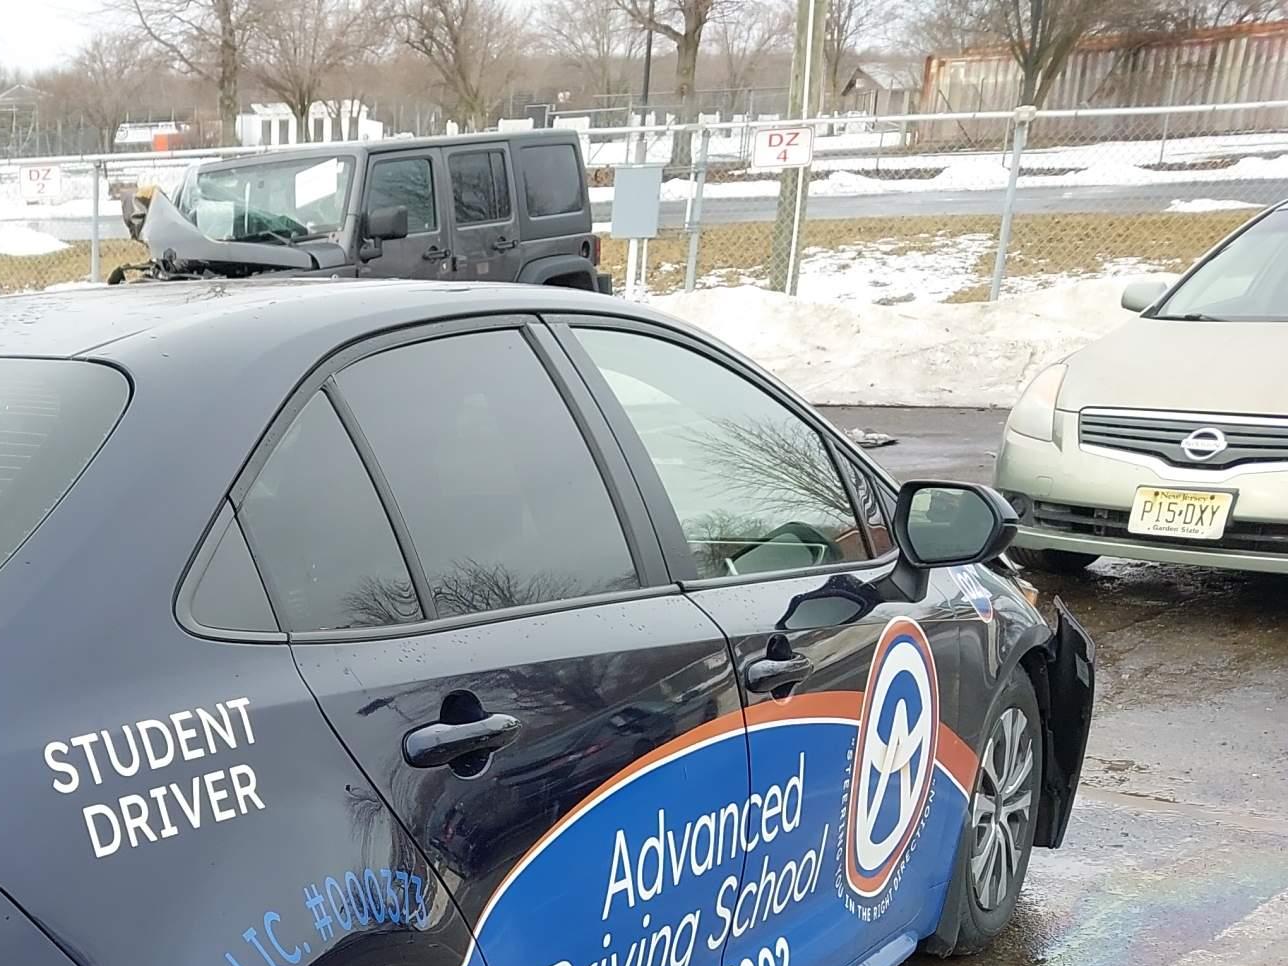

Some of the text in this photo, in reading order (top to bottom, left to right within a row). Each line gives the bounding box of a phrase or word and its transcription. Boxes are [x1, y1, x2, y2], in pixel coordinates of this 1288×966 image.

[768, 132, 800, 148] DZ
[776, 149, 789, 162] 4
[44, 697, 255, 793] STUDENT
[83, 764, 265, 858] DRIVER
[602, 752, 804, 920] Advanced
[707, 824, 829, 951] School
[856, 904, 872, 922] THE
[873, 889, 893, 921] RIGHT
